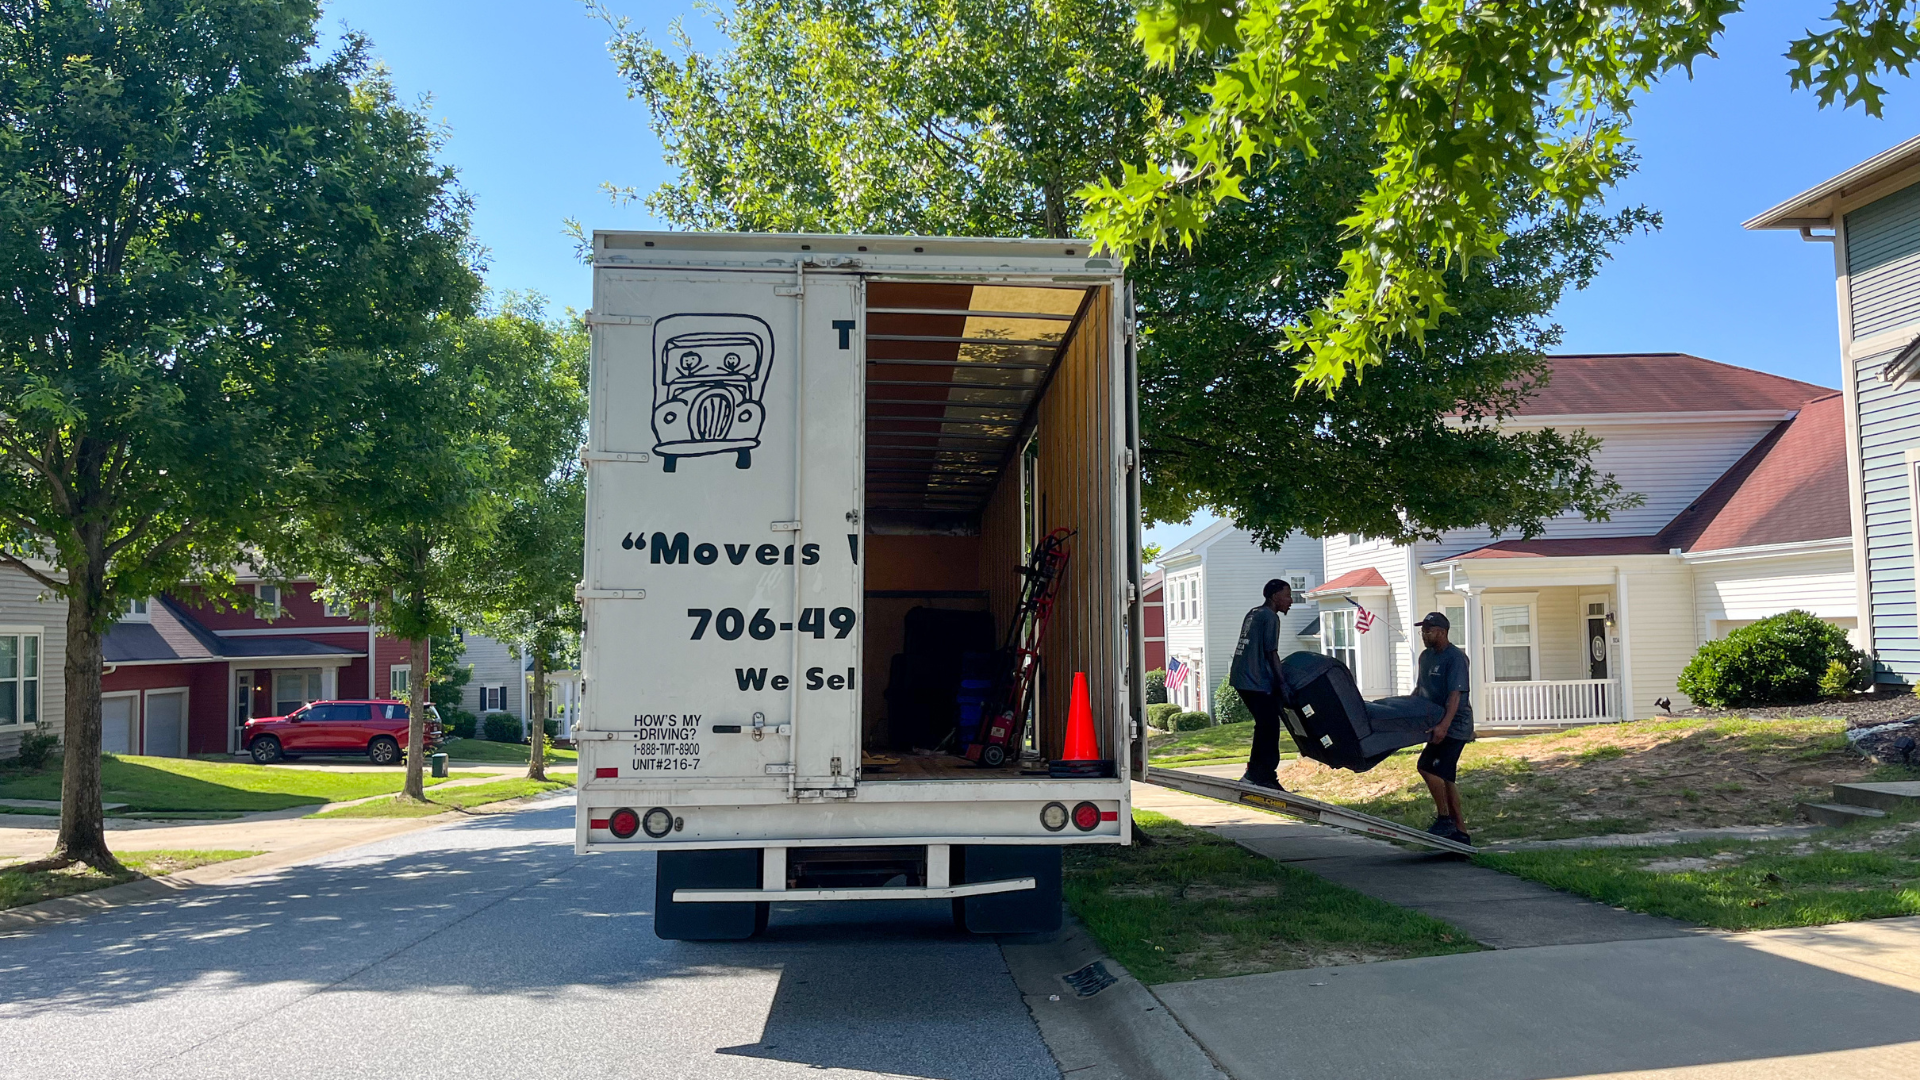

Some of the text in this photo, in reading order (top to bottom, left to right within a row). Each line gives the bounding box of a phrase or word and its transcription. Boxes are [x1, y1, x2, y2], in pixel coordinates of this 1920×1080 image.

[832, 320, 856, 350] T
[687, 606, 857, 641] 706-49
[735, 666, 855, 692] We Sel
[634, 714, 702, 727] HOW'S MY
[639, 728, 697, 740] DRIVING?
[633, 743, 700, 756] 1-888-TMT-8900
[632, 758, 701, 771] UNIT#216-7
